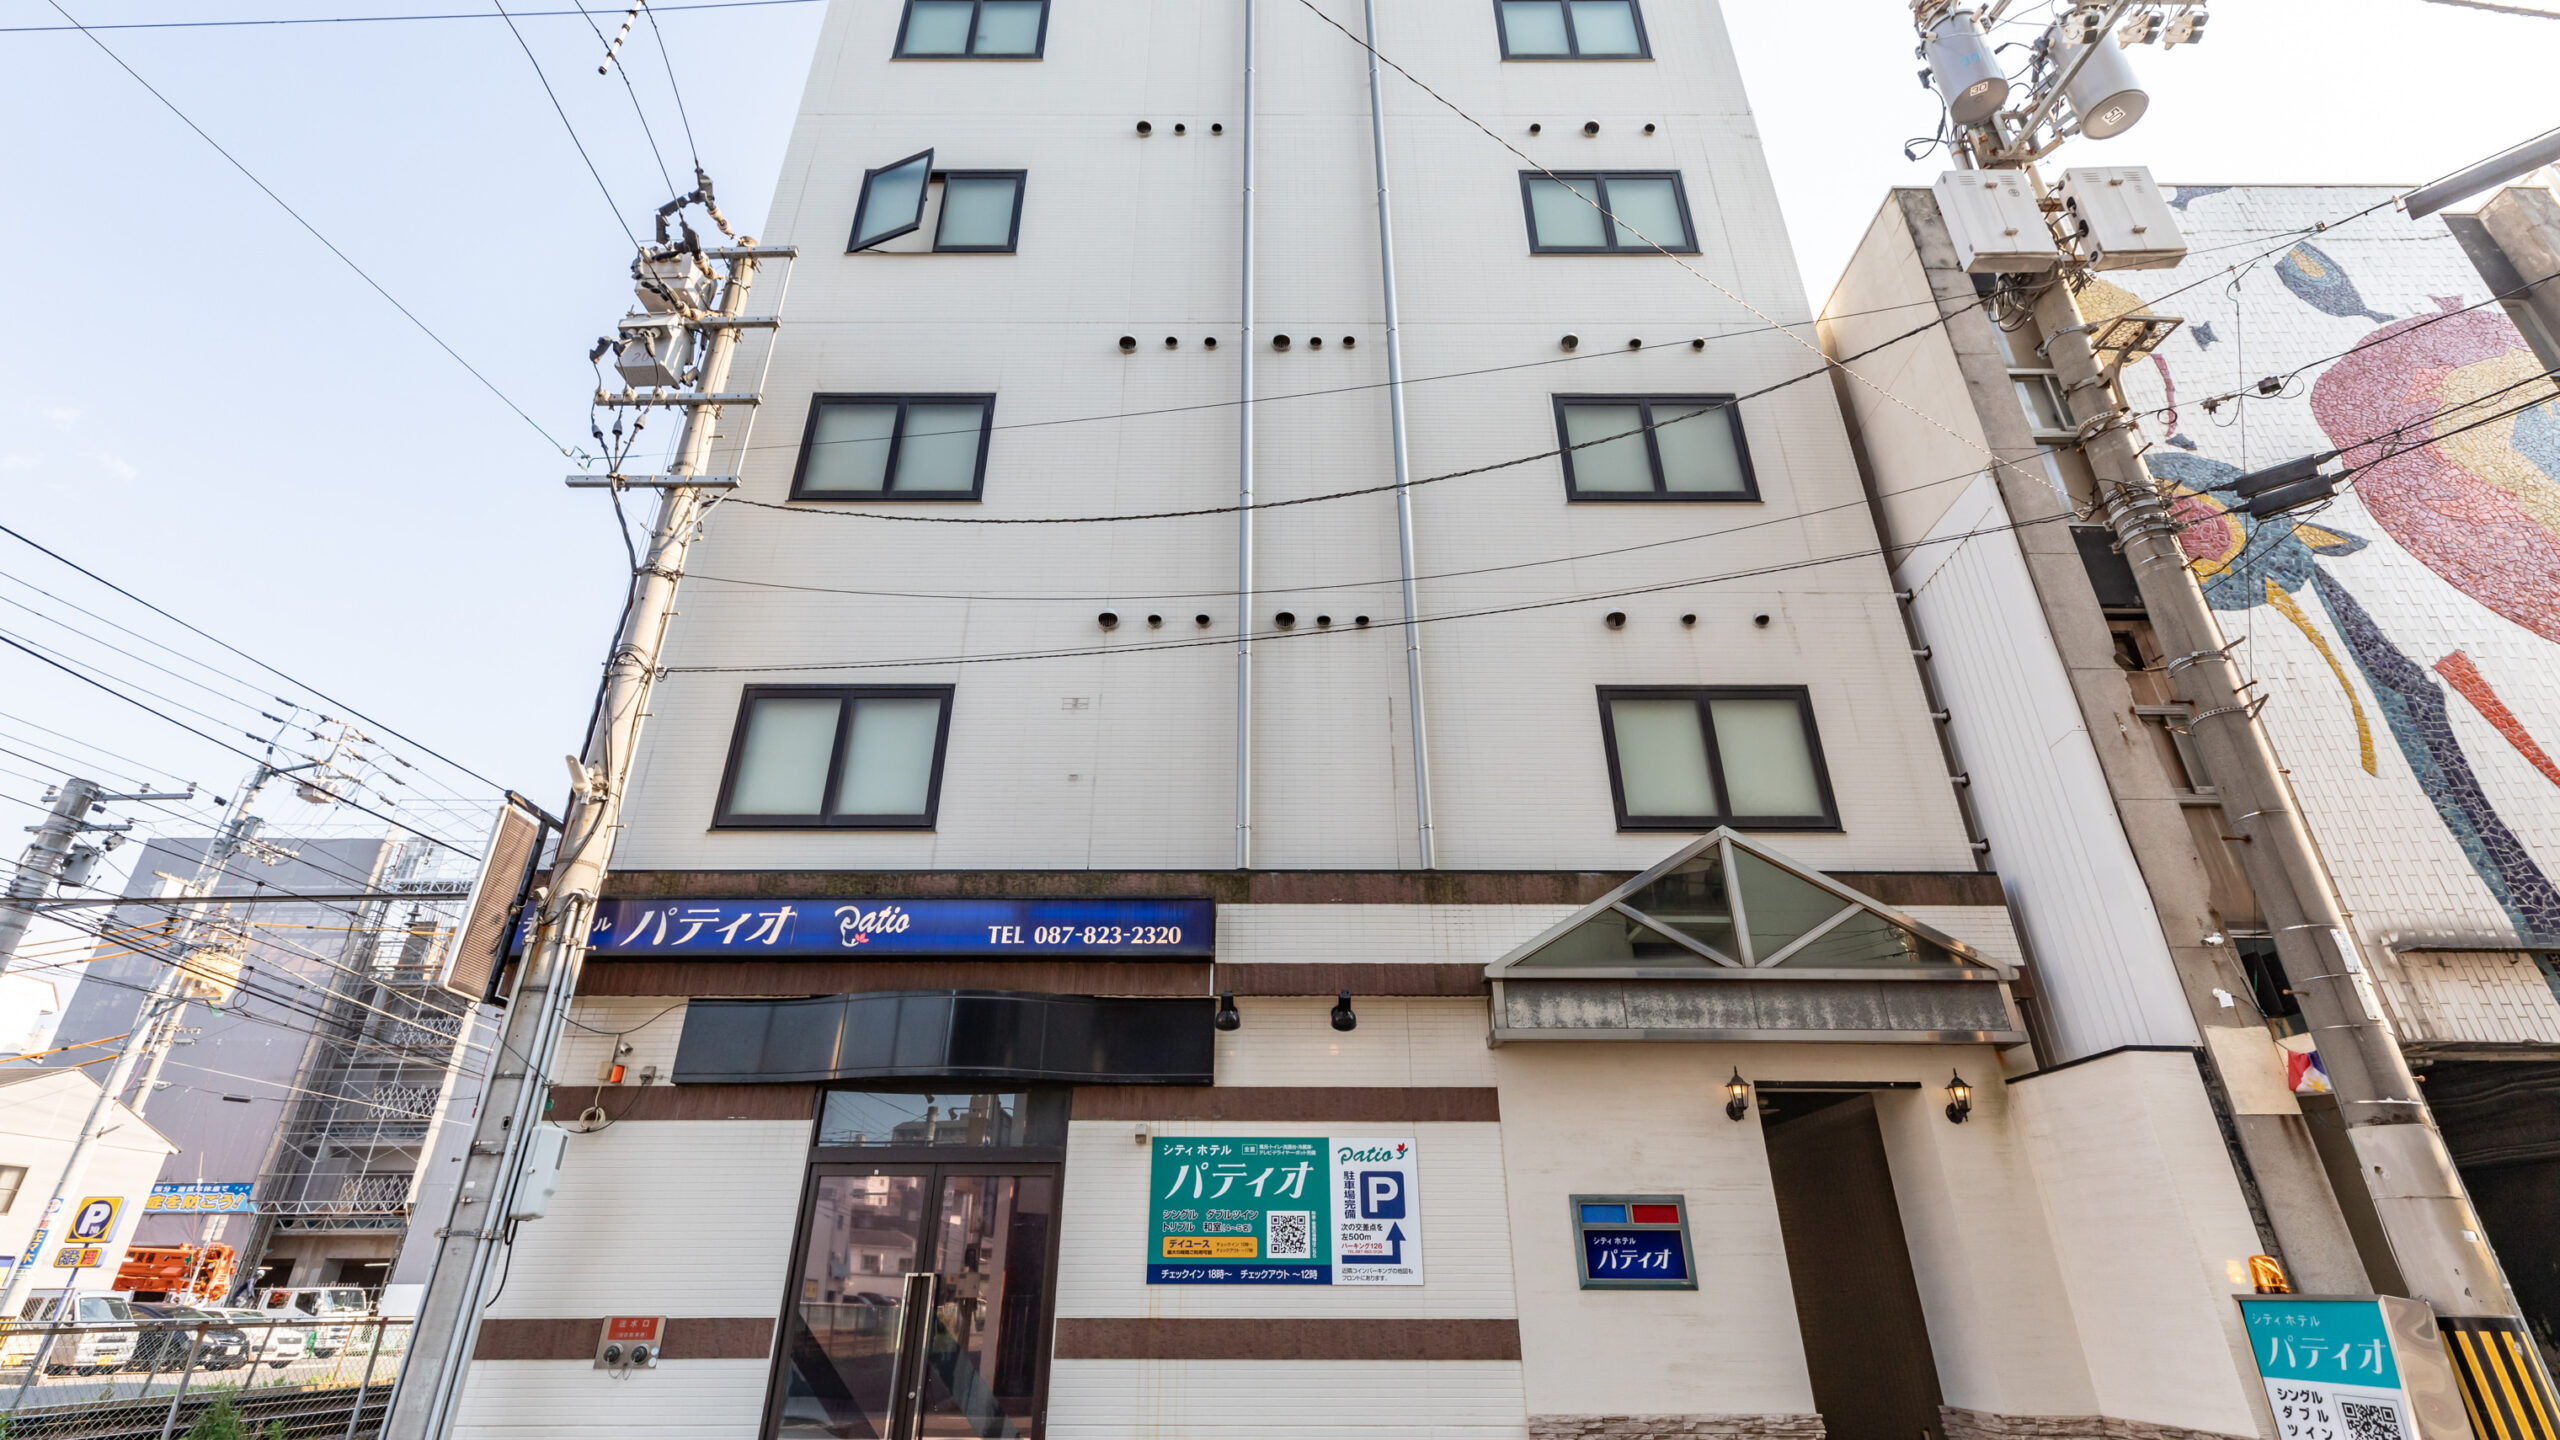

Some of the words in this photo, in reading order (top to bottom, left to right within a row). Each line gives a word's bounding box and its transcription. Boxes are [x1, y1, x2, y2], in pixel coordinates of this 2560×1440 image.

[1970, 82, 1988, 95] 30
[2105, 107, 2124, 123] 50
[619, 905, 797, 946] パティオ
[989, 926, 1024, 944] TEL
[1034, 926, 1182, 944] 087-823-2320
[1164, 1160, 1315, 1199] パティオ
[1343, 1170, 1356, 1219] 駐車場完備
[1368, 1176, 1399, 1213] P
[77, 1203, 112, 1235] P
[1163, 1209, 1198, 1219] シングル
[1341, 1223, 1383, 1232] 次の交差点を
[1341, 1233, 1372, 1241] 左500m
[1597, 1248, 1672, 1269] パティオ
[1161, 1269, 1205, 1279] チェックイン
[1240, 1269, 1290, 1279] チェックアウト
[2268, 1335, 2387, 1375] パティオ
[2277, 1387, 2323, 1405] シングル
[2283, 1406, 2329, 1424] ダブル
[2287, 1424, 2333, 1440] ツイン
